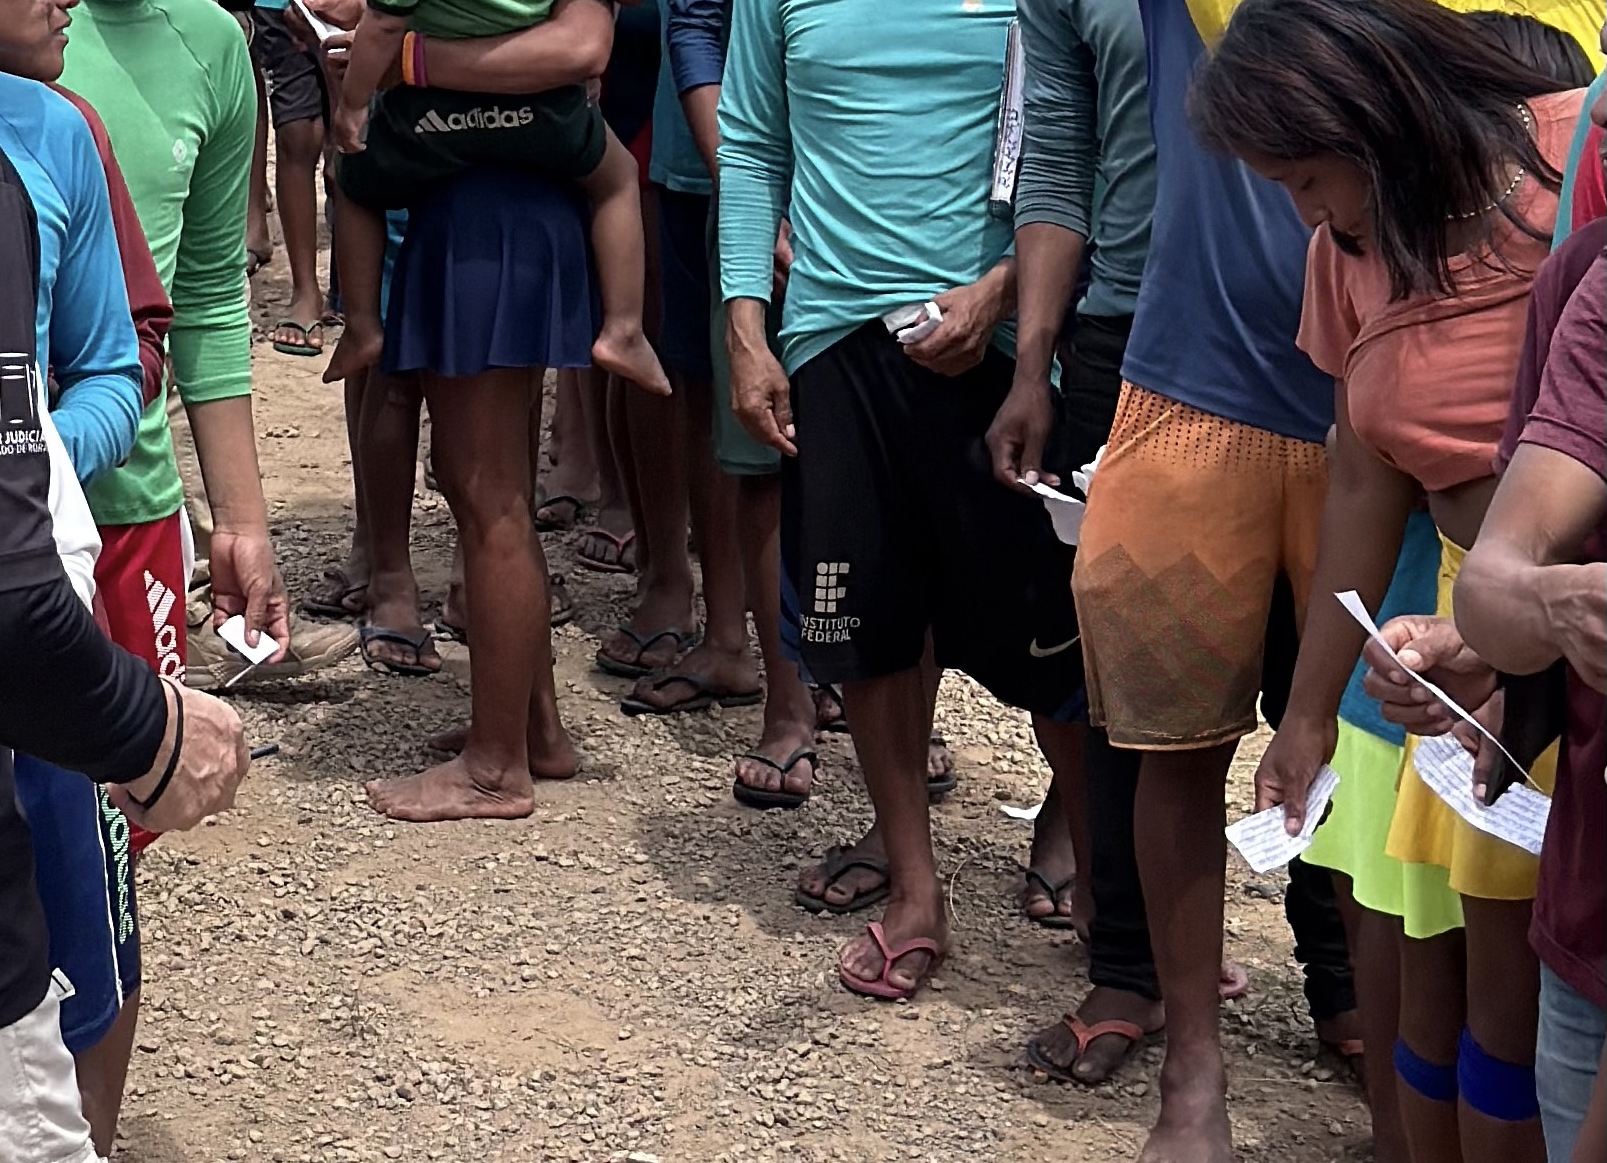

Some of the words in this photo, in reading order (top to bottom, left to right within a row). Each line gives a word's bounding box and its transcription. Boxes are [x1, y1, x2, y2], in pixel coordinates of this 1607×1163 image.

[447, 105, 534, 130] adidas
[16, 443, 26, 454] DE
[801, 628, 851, 643] FEDERAL
